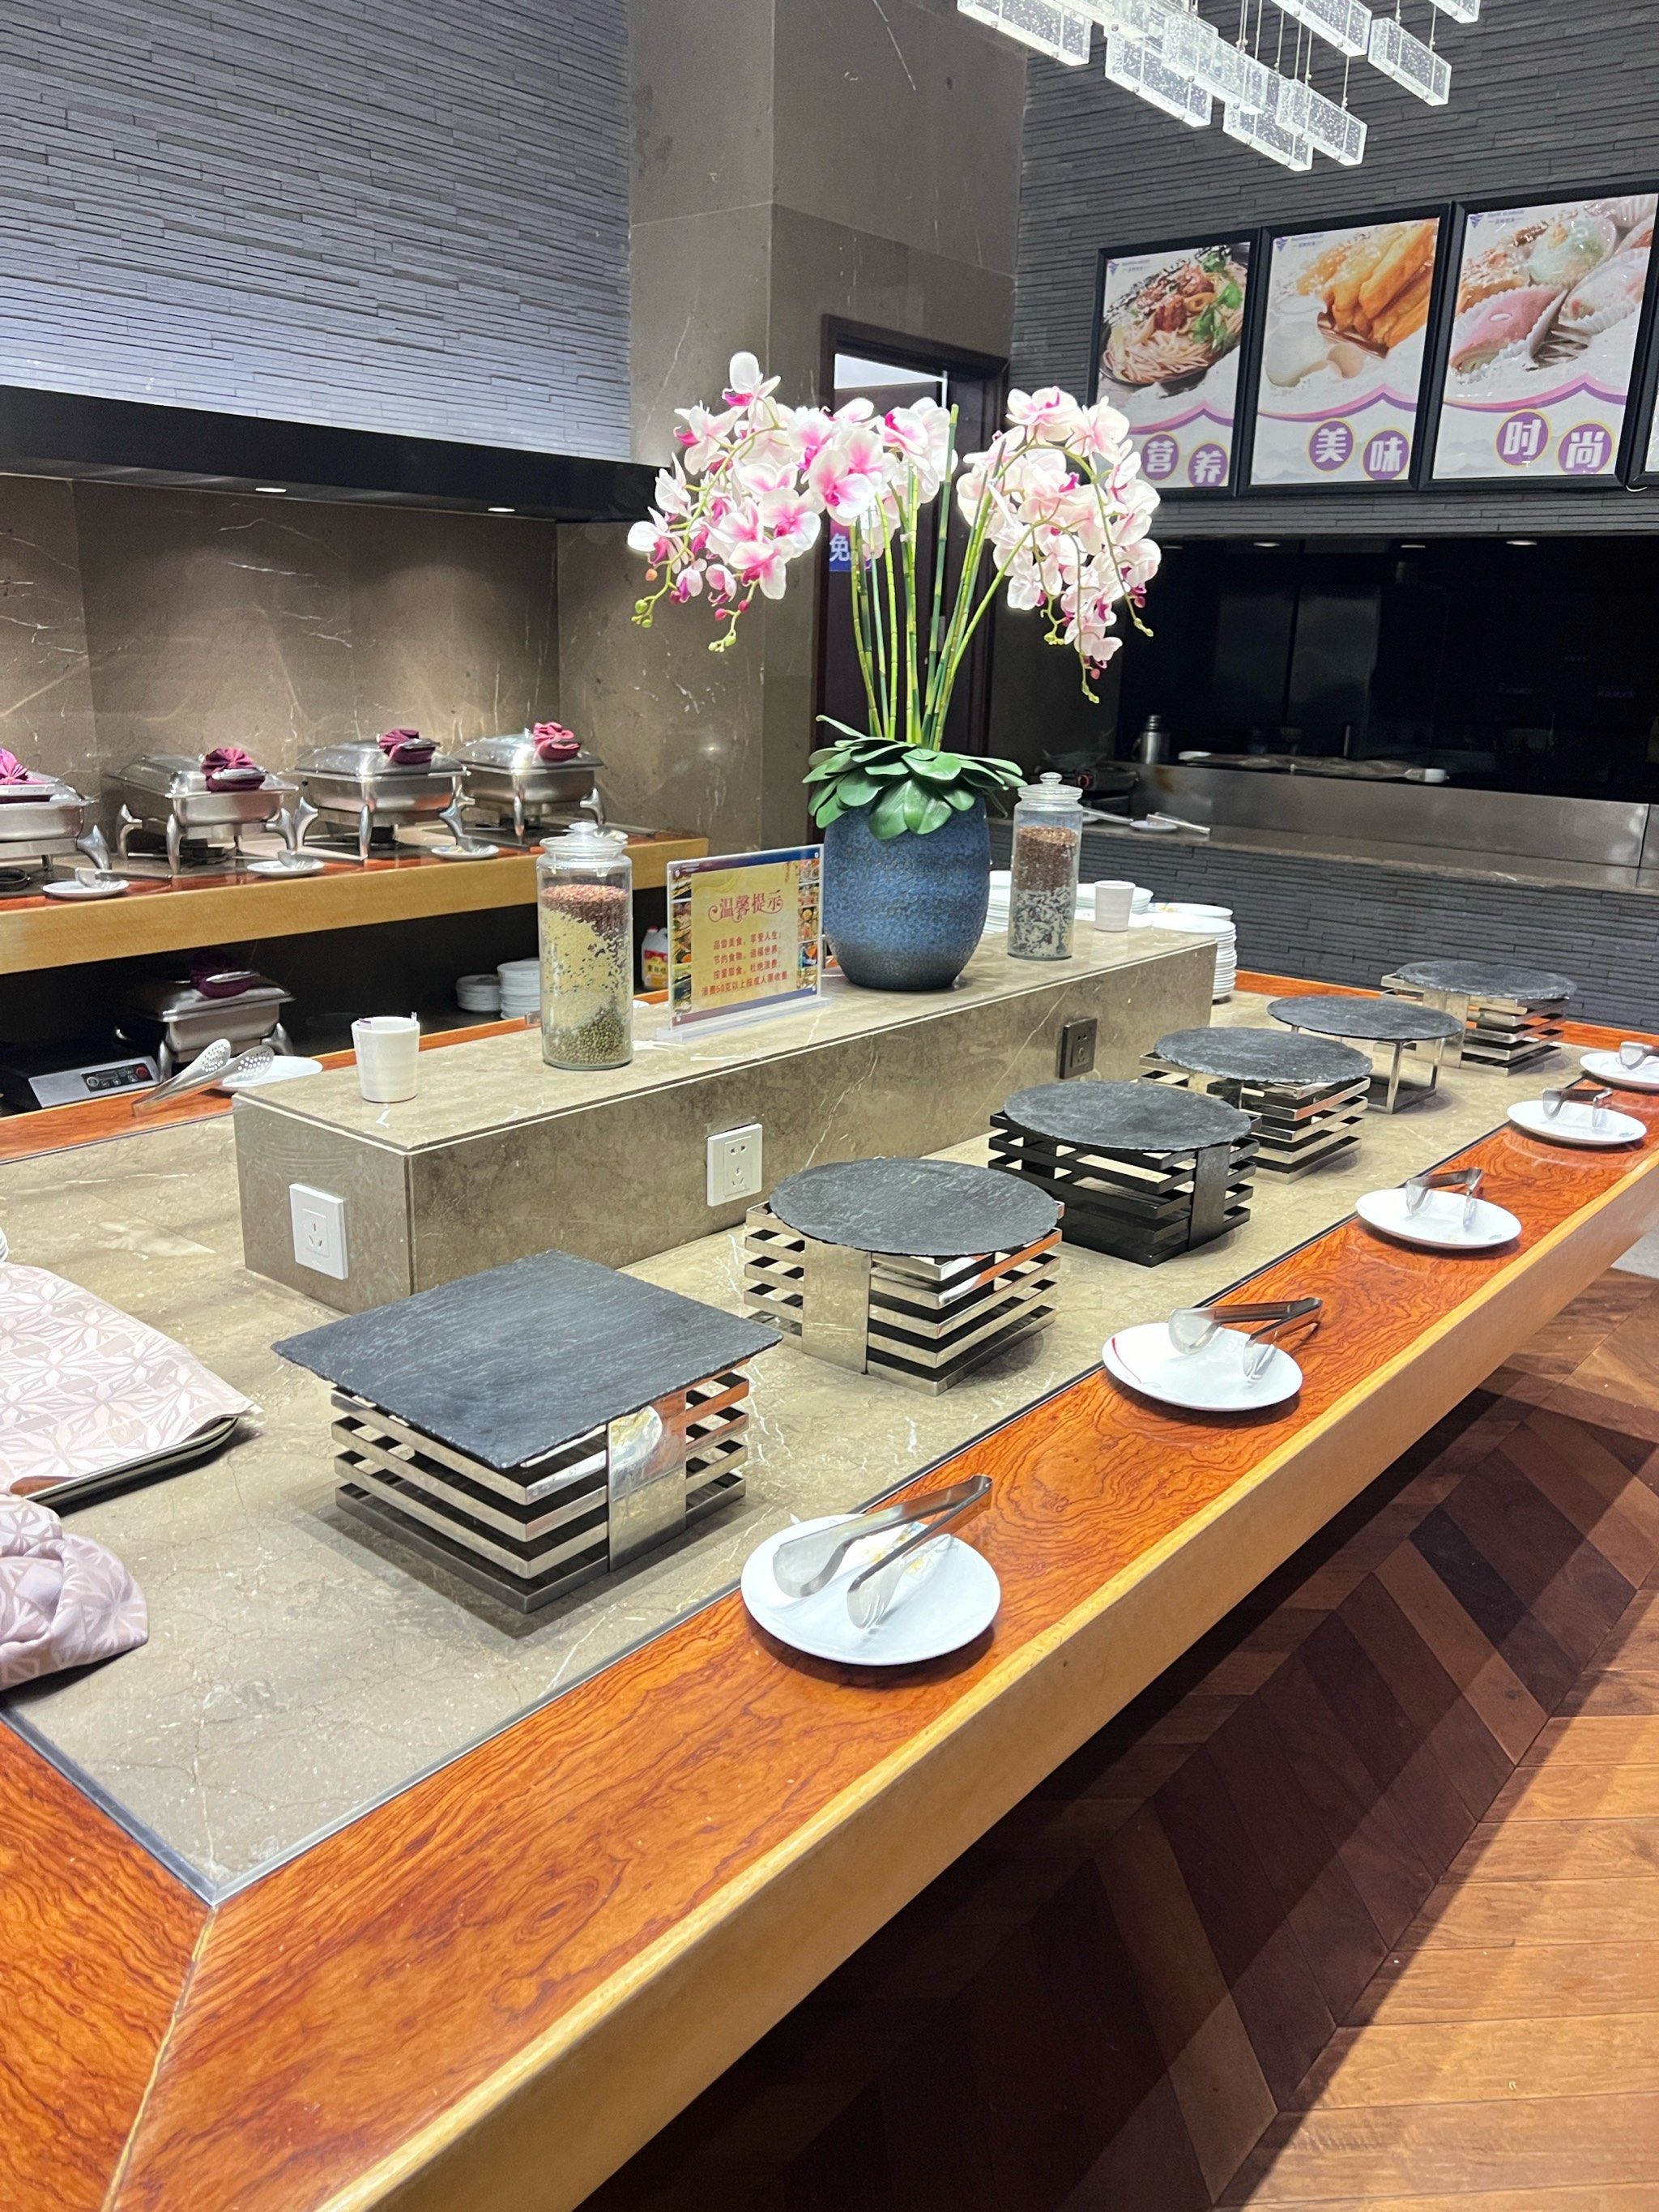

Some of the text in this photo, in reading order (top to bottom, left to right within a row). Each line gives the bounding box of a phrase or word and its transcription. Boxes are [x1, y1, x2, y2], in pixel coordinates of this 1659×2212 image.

[1146, 440, 1222, 483] 营养
[1316, 427, 1403, 472] 美味
[1503, 419, 1606, 468] 时尚
[708, 889, 783, 923] 温馨提示
